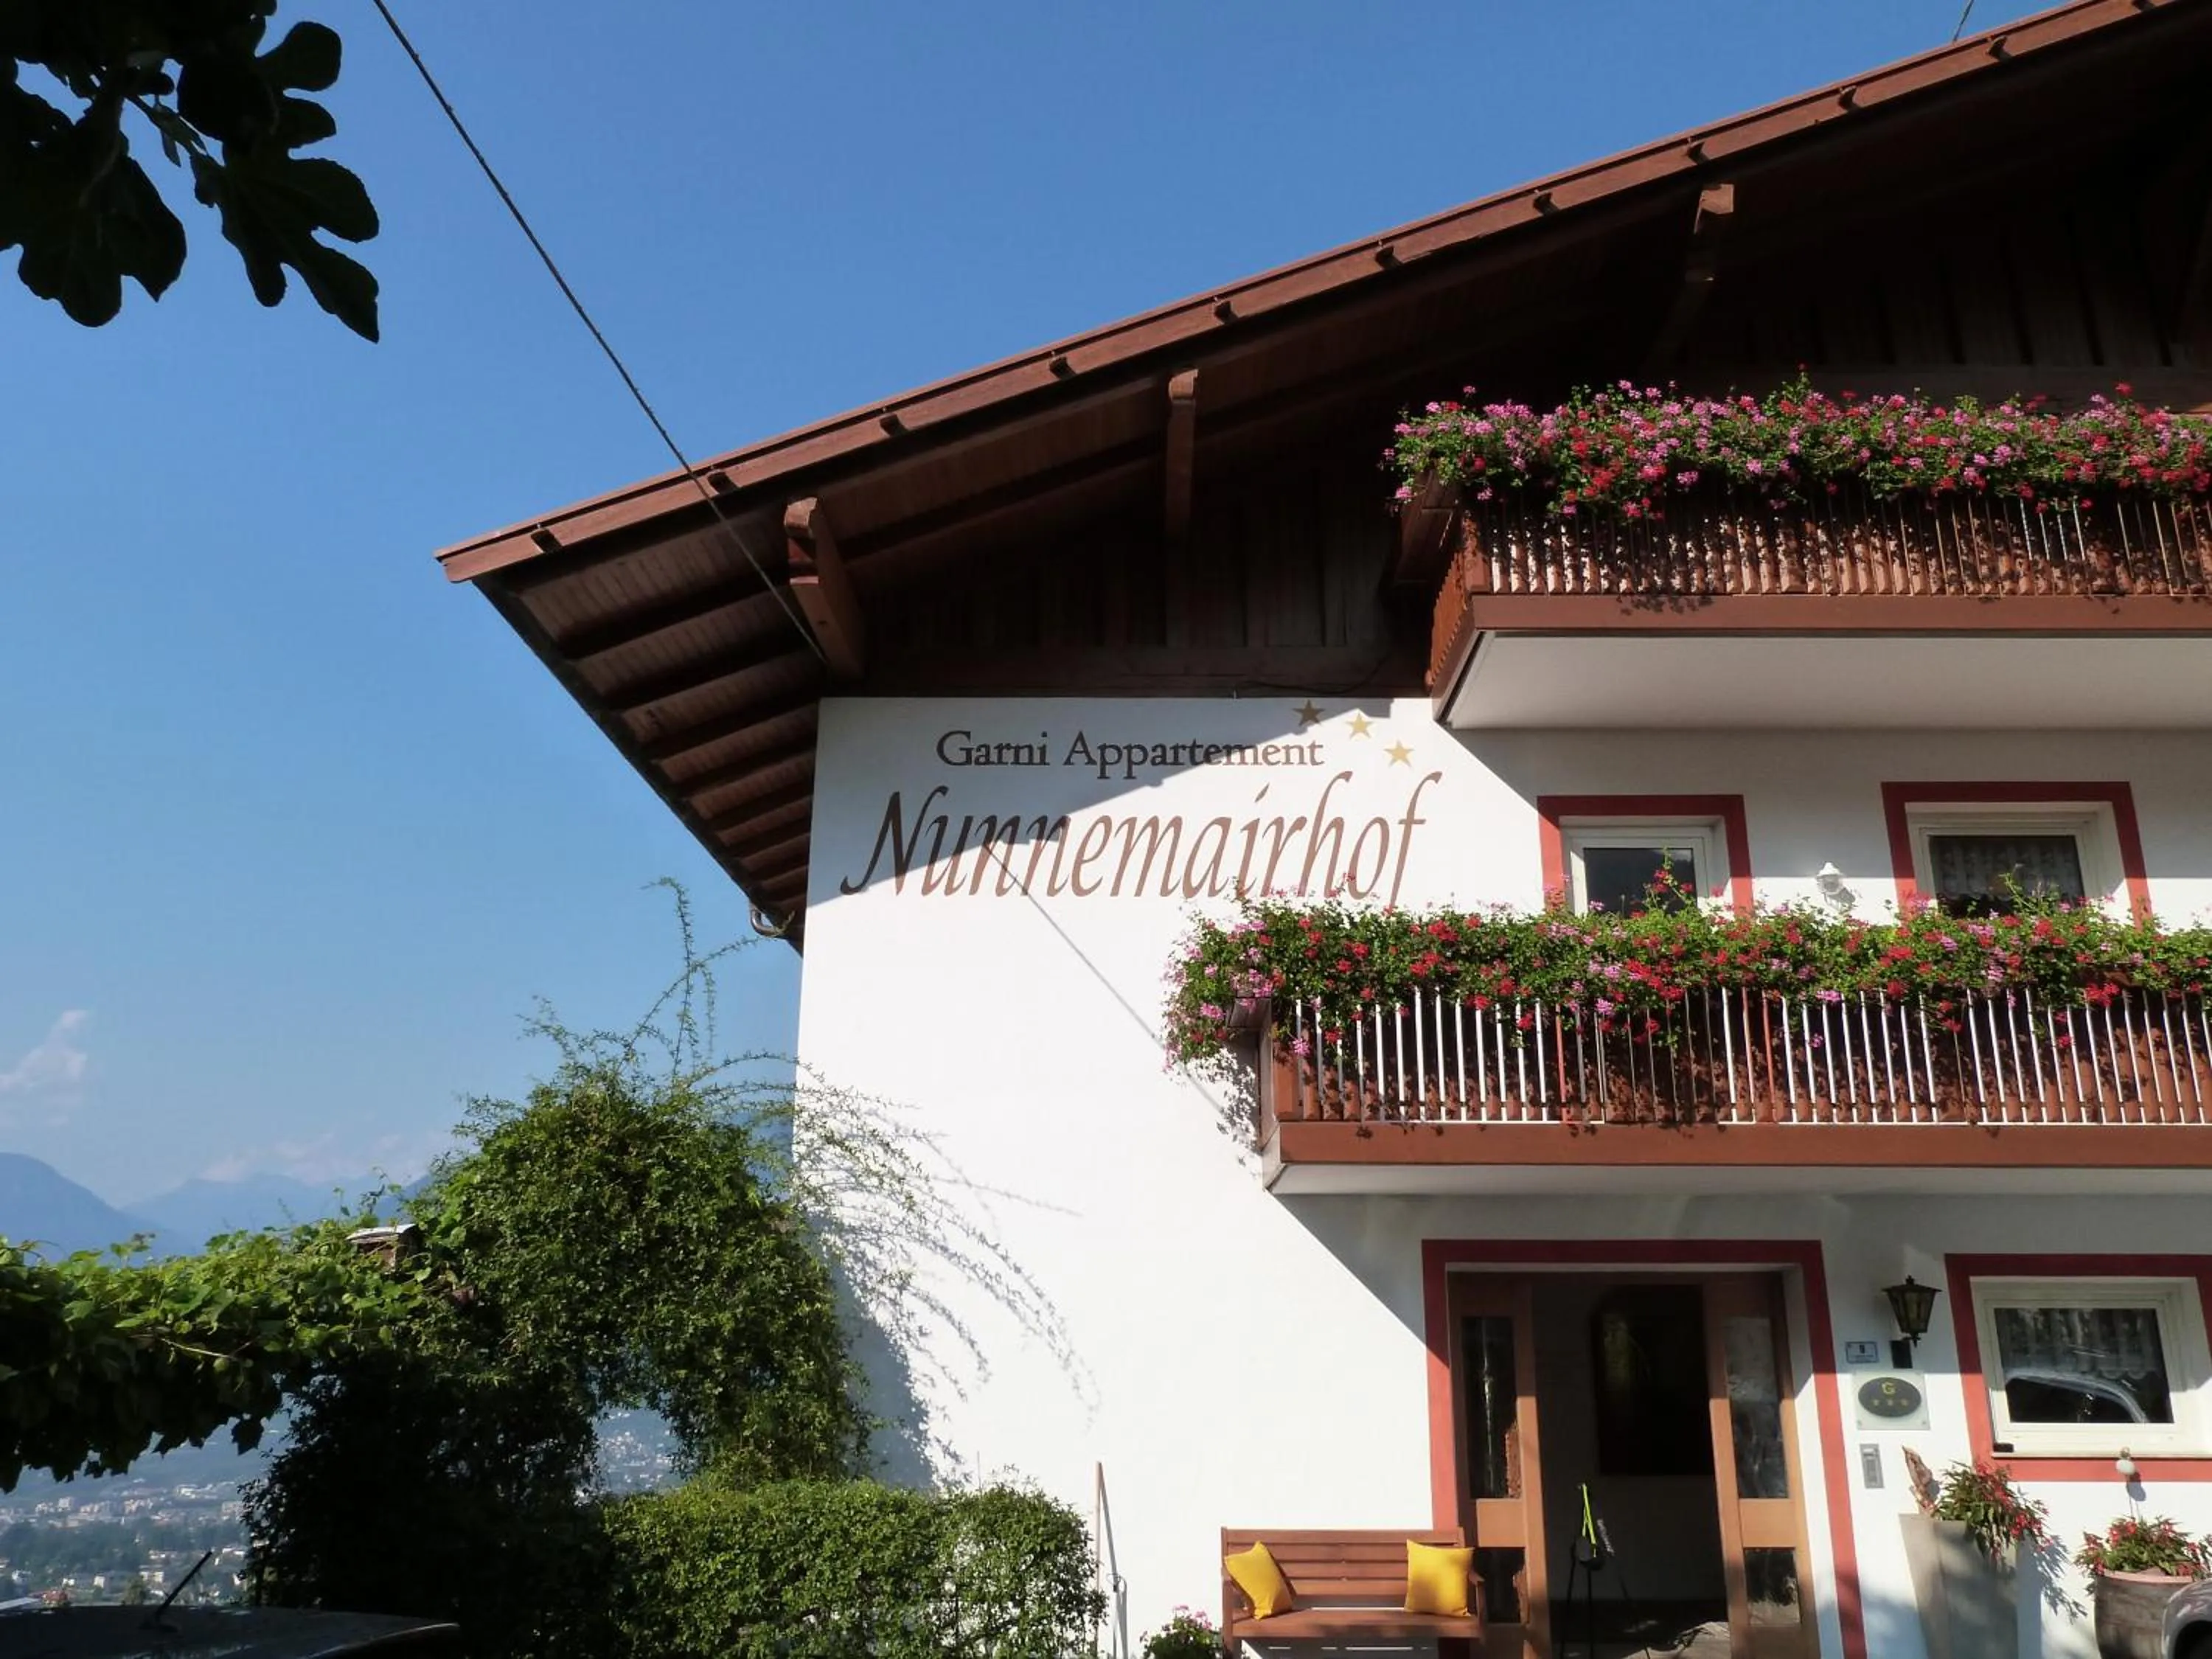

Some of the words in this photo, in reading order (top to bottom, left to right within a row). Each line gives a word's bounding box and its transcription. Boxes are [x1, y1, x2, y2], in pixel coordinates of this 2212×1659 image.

[936, 730, 1050, 766] Garni
[1063, 731, 1324, 779] Appartement
[841, 771, 1442, 908] Nunnemairhof
[1882, 1382, 1896, 1394] G
